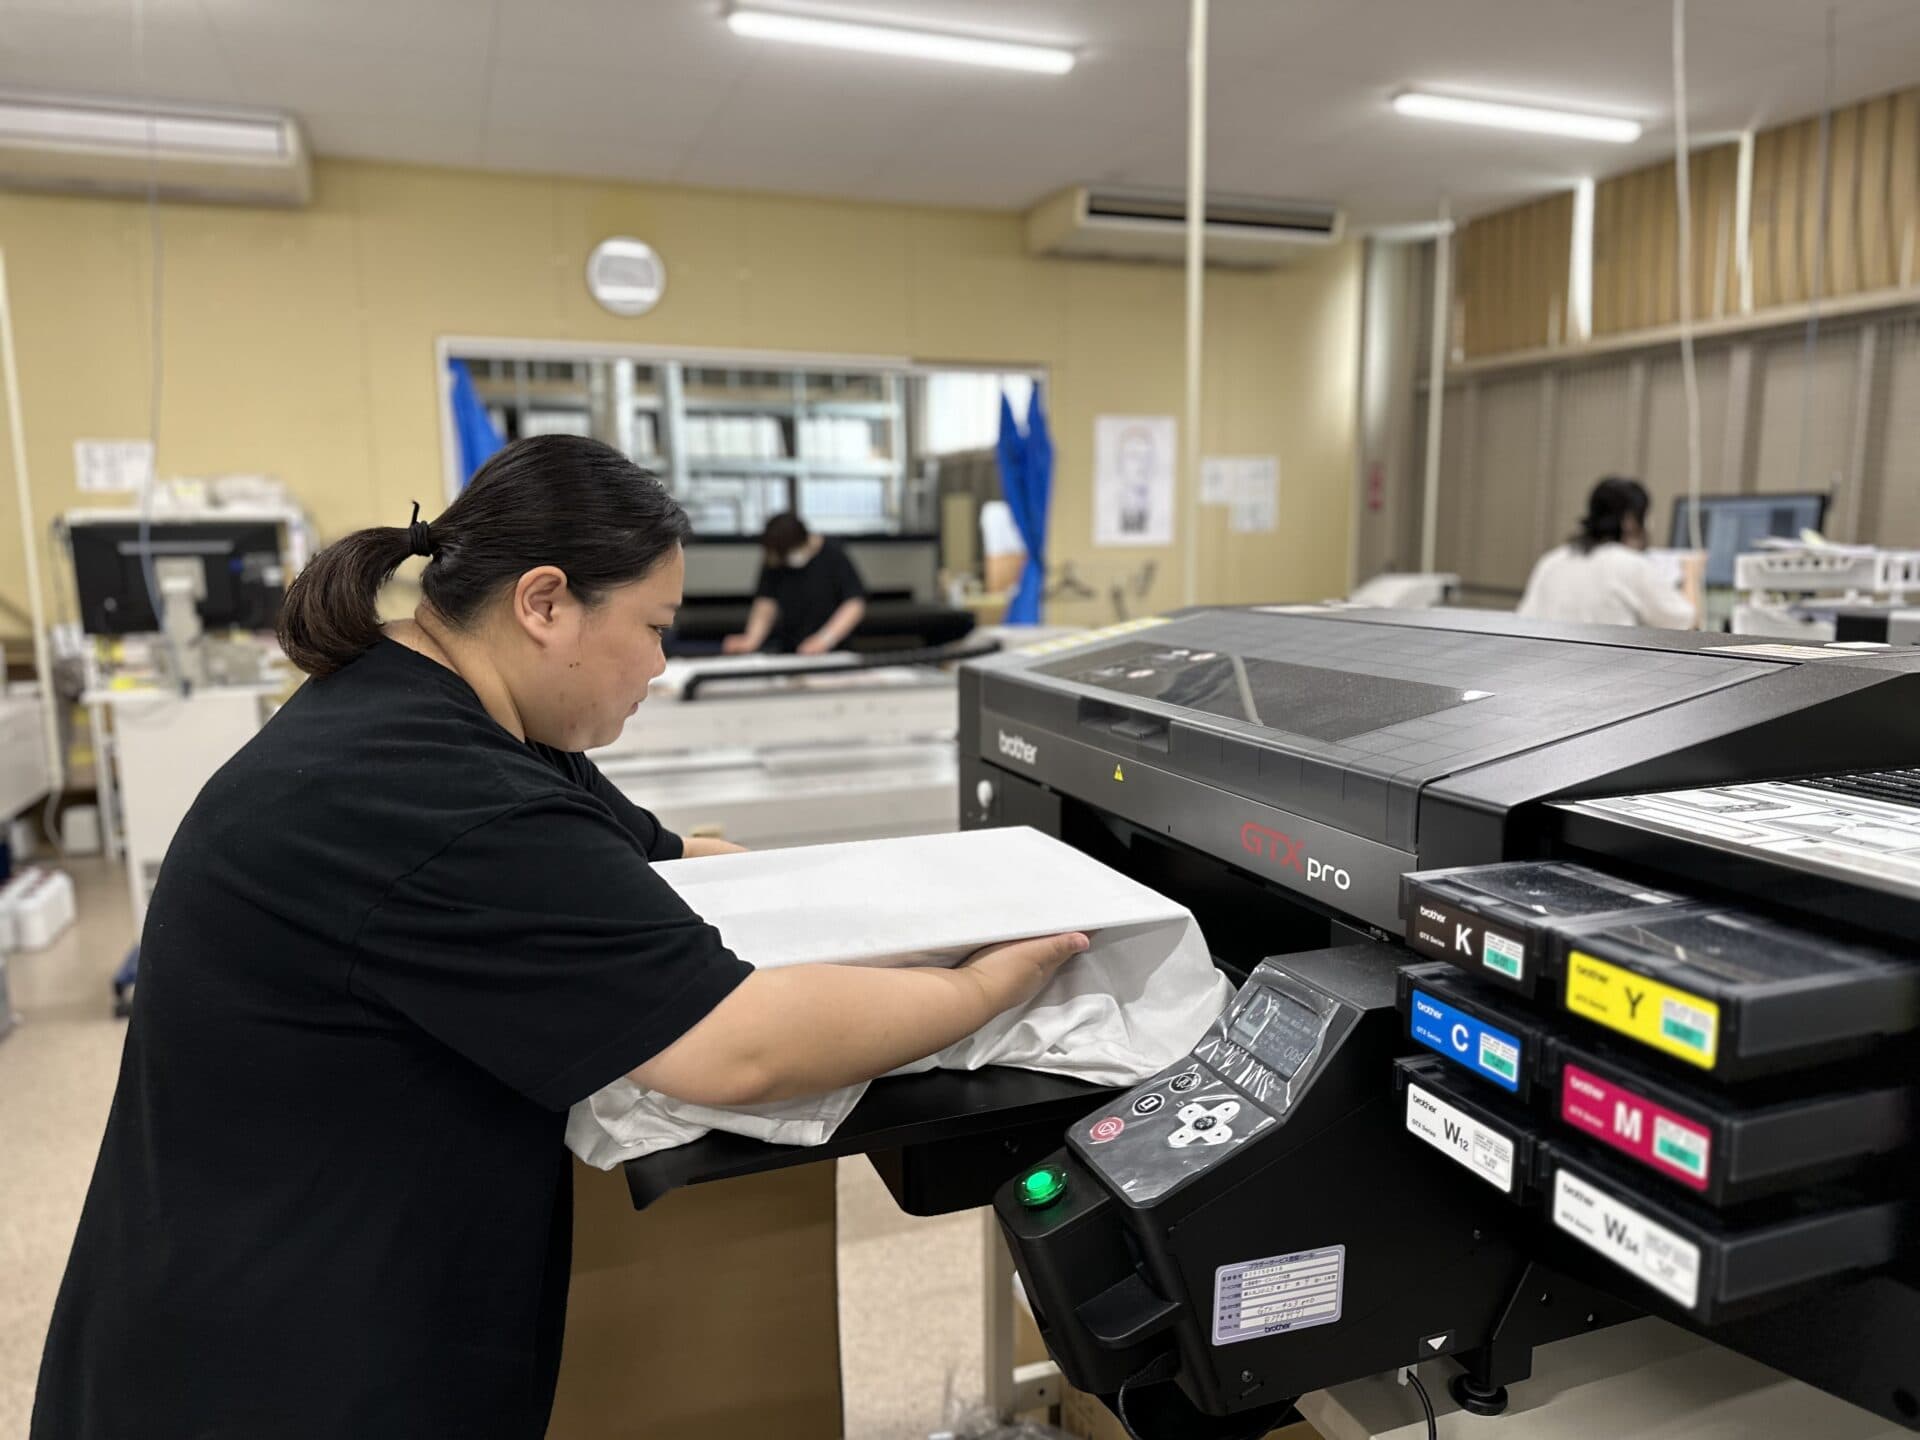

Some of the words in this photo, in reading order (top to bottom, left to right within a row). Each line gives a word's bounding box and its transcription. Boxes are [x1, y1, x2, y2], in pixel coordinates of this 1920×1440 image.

[999, 729, 1038, 765] brother
[1241, 821, 1304, 876] GTX
[1307, 857, 1351, 890] pro
[1420, 905, 1446, 923] brother
[1455, 923, 1472, 956] K
[1417, 1000, 1443, 1019] brother
[1624, 985, 1644, 1019] Y
[1451, 1023, 1469, 1052] C
[1413, 1094, 1437, 1114] brother
[1613, 1101, 1643, 1143] M
[1264, 1321, 1291, 1334] brother
